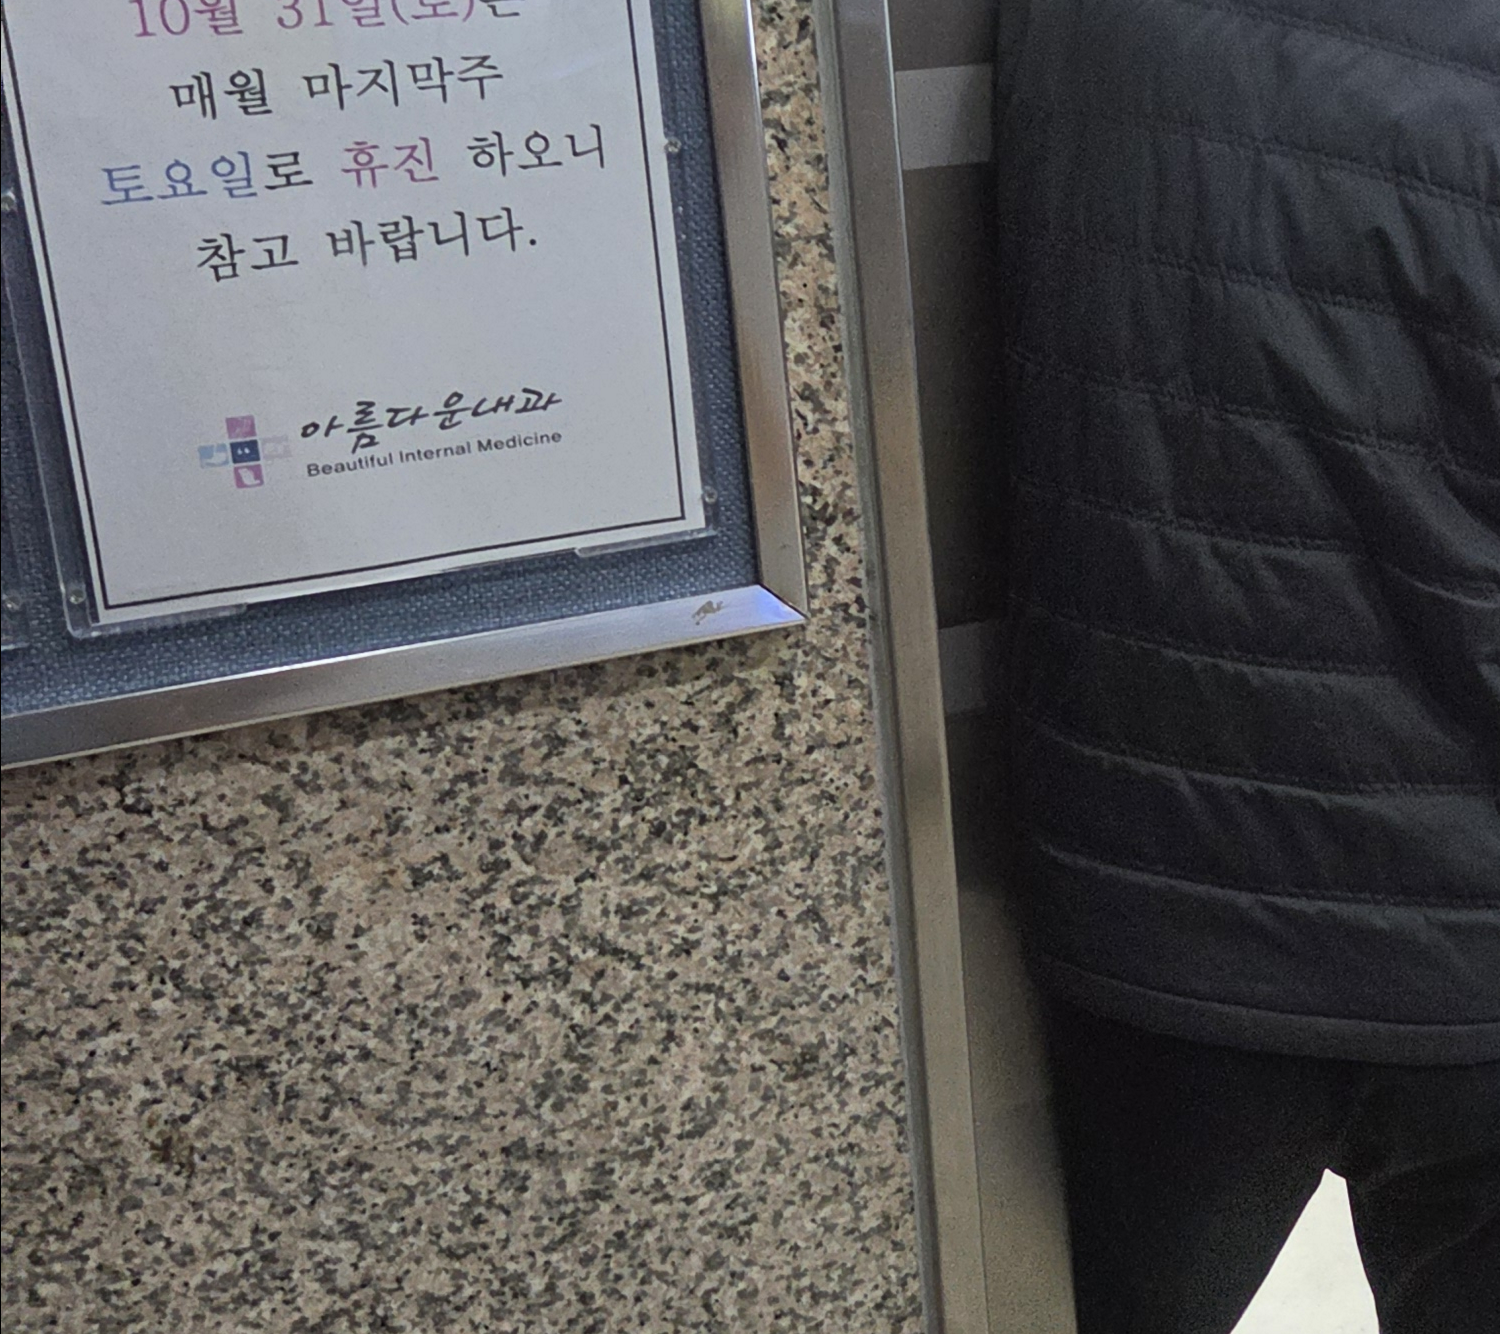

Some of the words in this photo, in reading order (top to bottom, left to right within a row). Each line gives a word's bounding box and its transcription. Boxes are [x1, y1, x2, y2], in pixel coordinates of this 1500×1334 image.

[168, 68, 275, 120] 매월
[302, 54, 504, 111] 마지막주
[101, 151, 314, 206] 토요일로
[341, 136, 441, 188] 휴진
[467, 123, 606, 177] 하오니
[195, 232, 300, 283] 참고
[326, 207, 540, 267] 바랍니다.
[299, 387, 563, 454] 아름다운내과
[306, 452, 395, 478] Beautiful
[398, 440, 473, 466] Internal
[476, 429, 564, 454] Medicine
